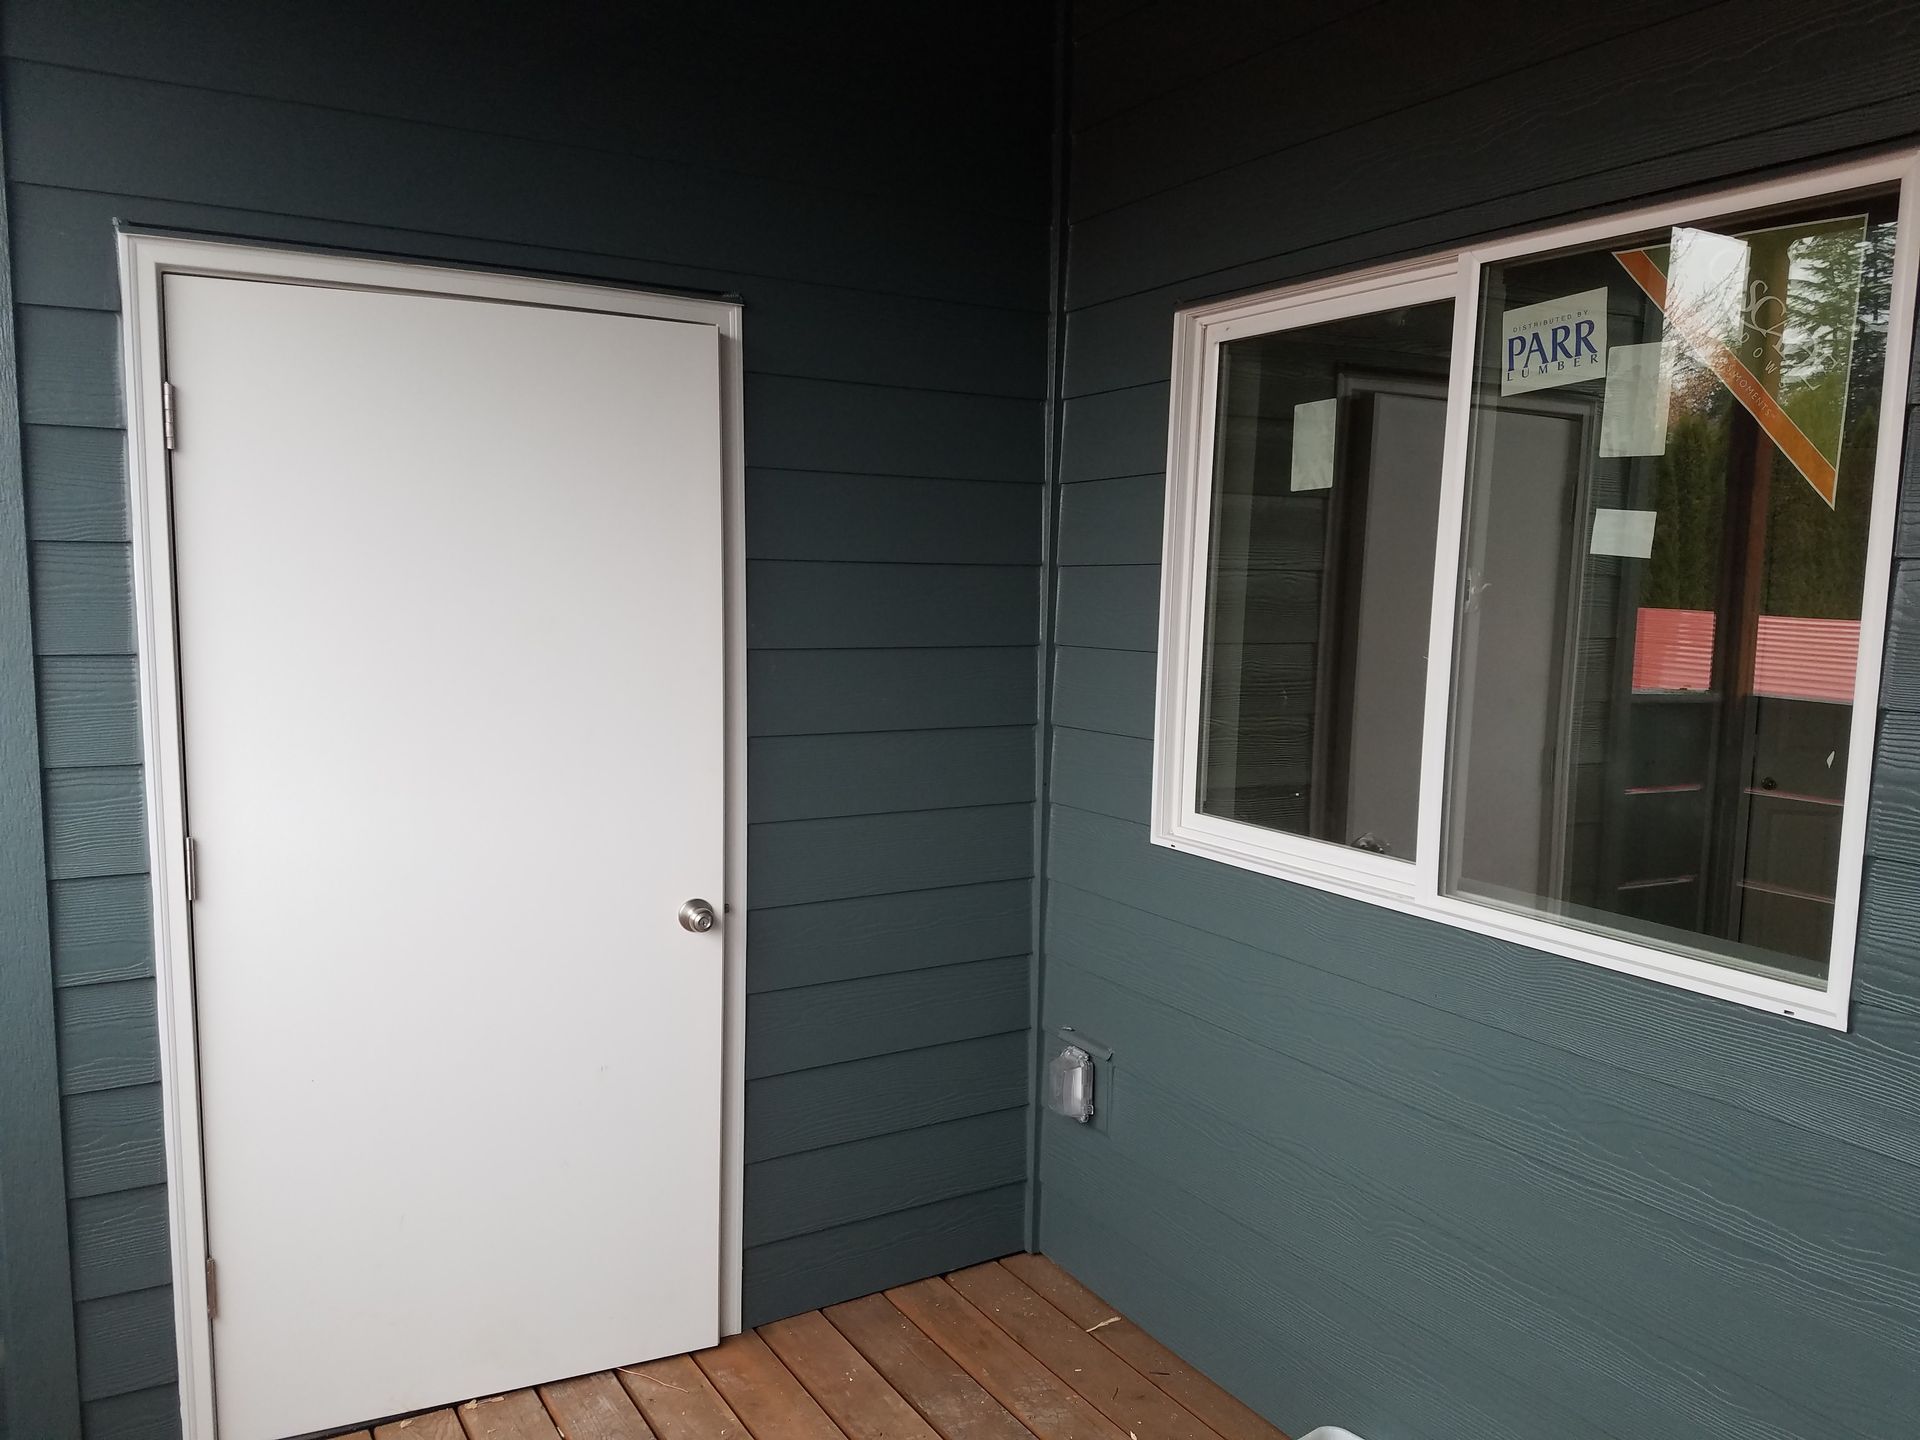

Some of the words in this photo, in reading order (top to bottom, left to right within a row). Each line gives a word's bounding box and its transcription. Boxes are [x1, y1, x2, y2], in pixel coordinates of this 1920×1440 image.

[1513, 314, 1572, 333] DISTRIBUTED
[1577, 310, 1589, 318] BY
[1507, 320, 1598, 371] PARR
[1507, 354, 1598, 381] LUMBER
